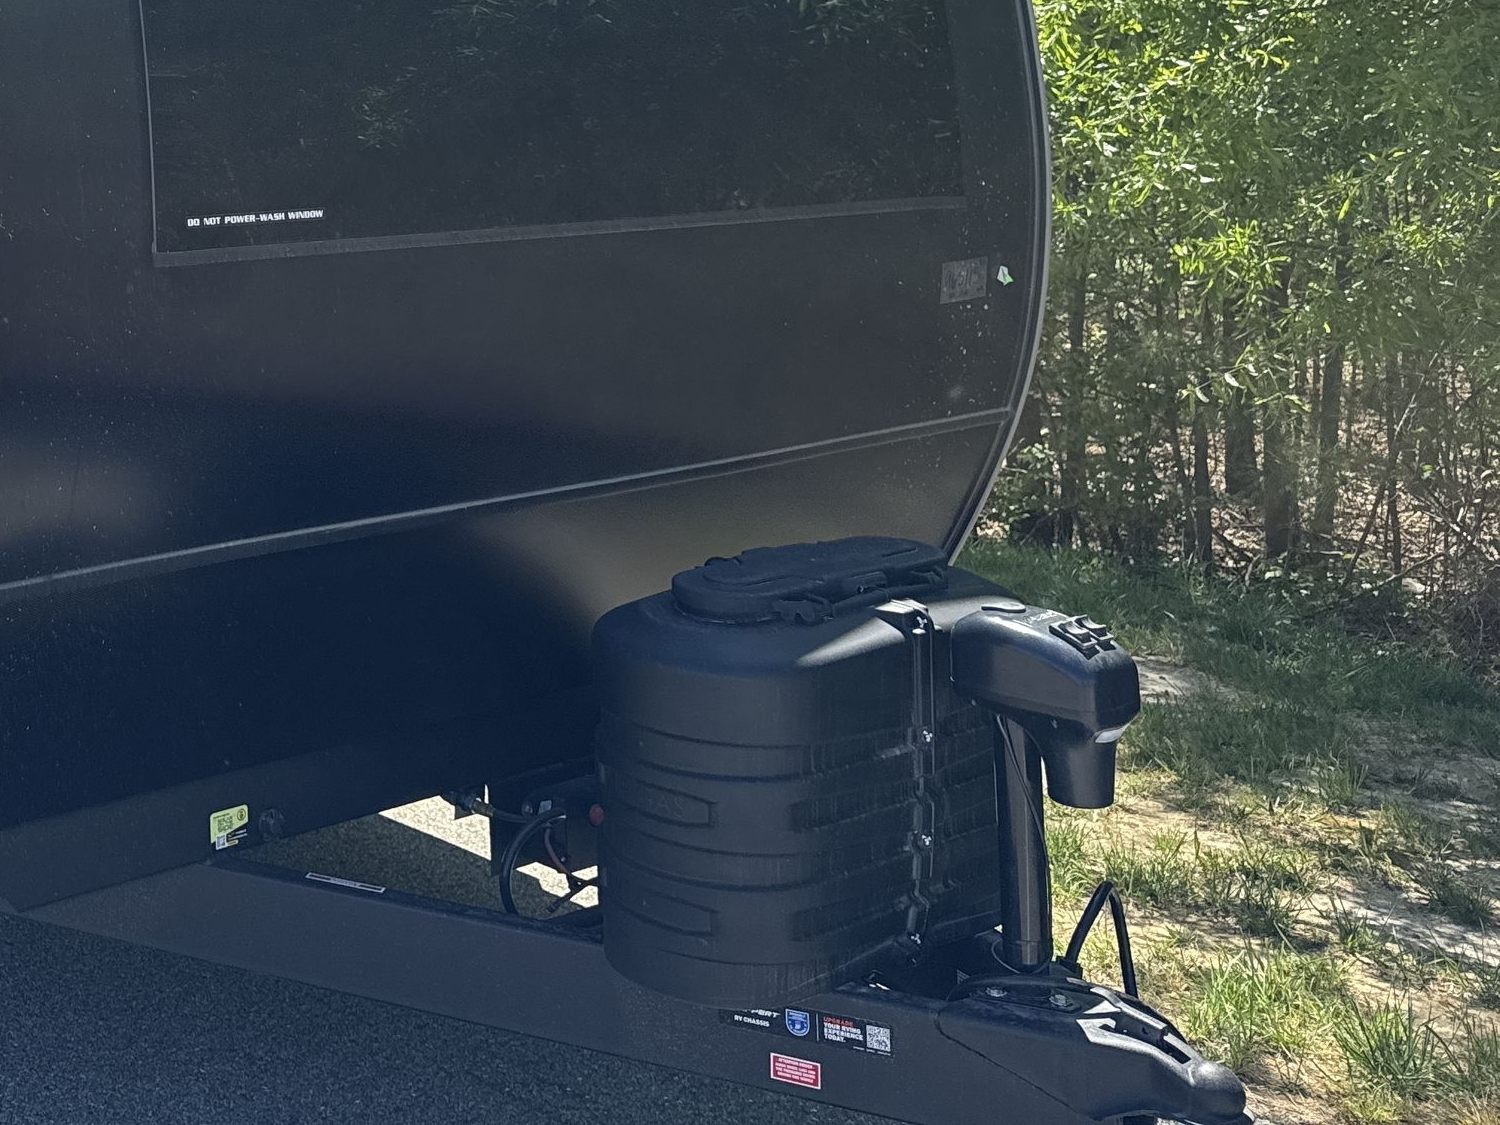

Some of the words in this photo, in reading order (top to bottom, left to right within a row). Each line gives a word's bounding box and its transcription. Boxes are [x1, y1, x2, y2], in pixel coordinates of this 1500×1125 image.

[187, 218, 200, 227] DO
[204, 216, 221, 226] NOT
[225, 213, 285, 224] POWER-WASH
[288, 209, 324, 220] WINDOW
[733, 1014, 743, 1022] RV
[743, 1016, 771, 1028] CHASSIS
[824, 1022, 841, 1031] YOUR
[824, 1027, 864, 1041] EXPERIENCE
